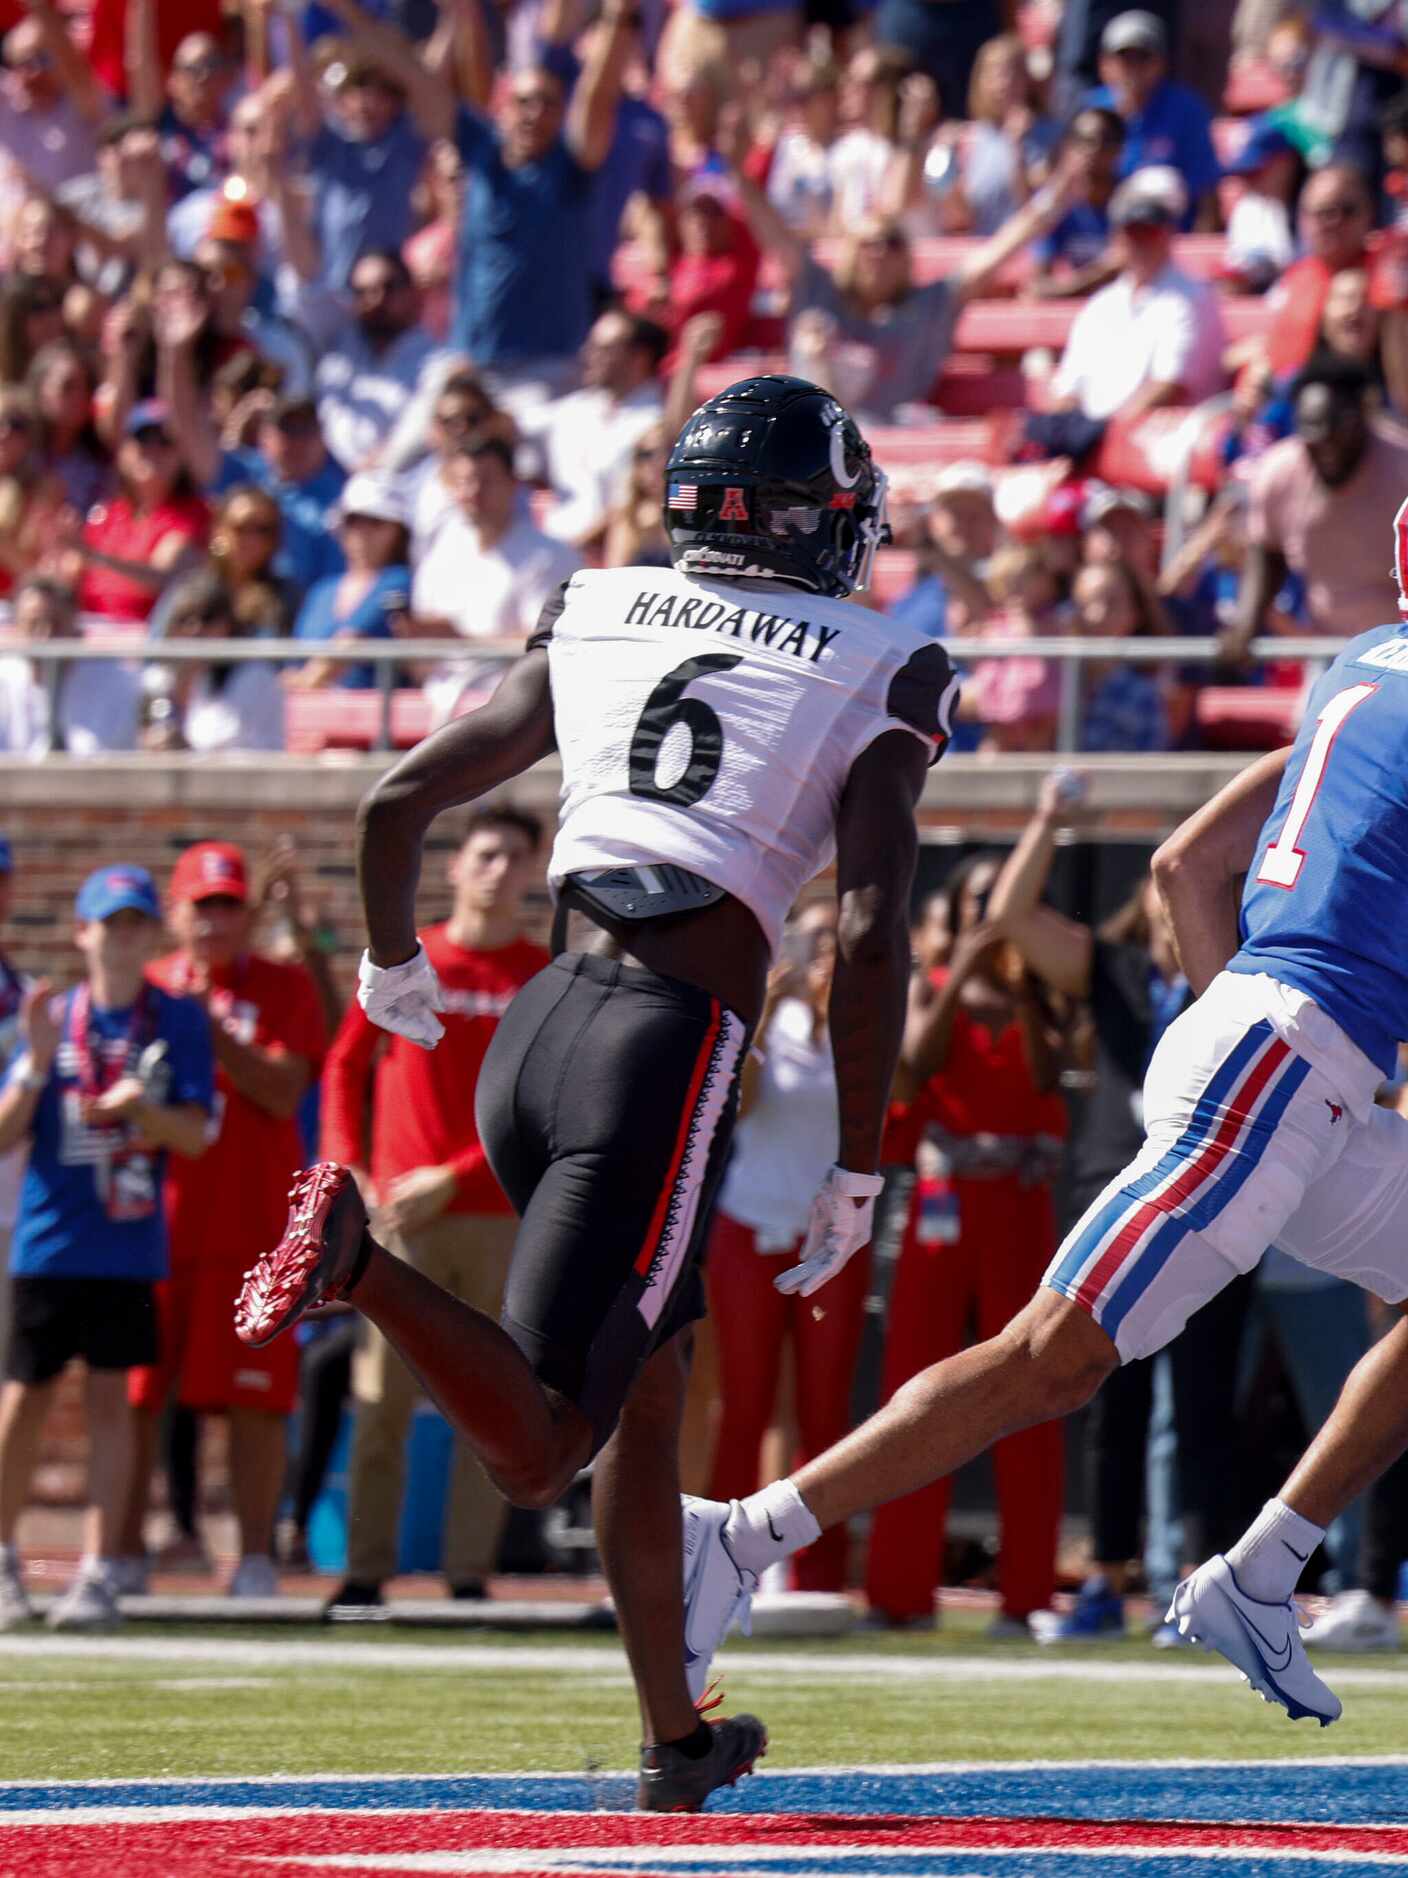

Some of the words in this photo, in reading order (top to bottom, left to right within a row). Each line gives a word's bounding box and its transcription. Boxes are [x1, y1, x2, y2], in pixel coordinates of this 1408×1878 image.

[624, 591, 842, 663] HARDAWAY
[628, 653, 744, 807] 6
[1256, 681, 1381, 891] 1
